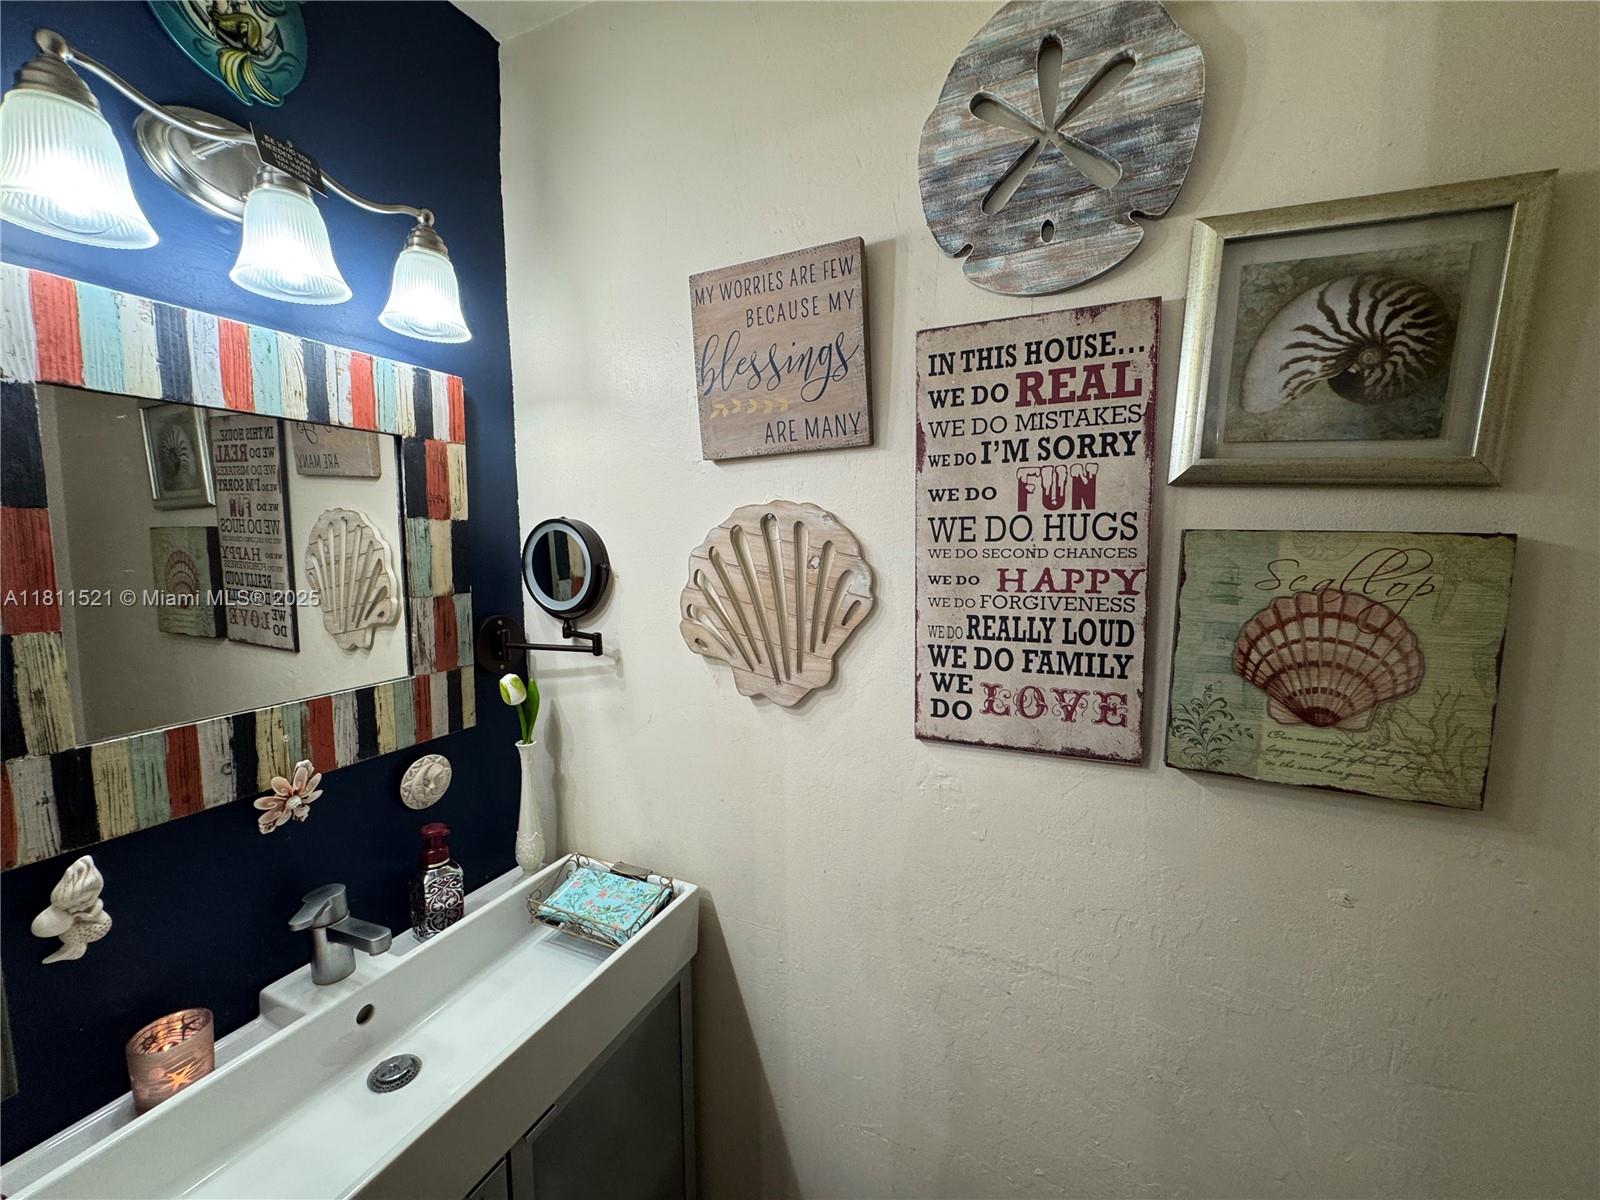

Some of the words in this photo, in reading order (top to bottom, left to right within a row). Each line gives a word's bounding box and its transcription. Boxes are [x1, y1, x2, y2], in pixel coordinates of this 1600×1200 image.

[695, 286, 714, 307] MY
[720, 270, 783, 301] WORRIES
[790, 264, 816, 288] ARE
[823, 255, 854, 280] FEW
[746, 296, 820, 328] BECAUSE
[829, 288, 854, 313] MY
[700, 329, 859, 402] blessings
[928, 351, 955, 377] IN
[961, 343, 1017, 372] THIS
[1024, 330, 1145, 366] HOUSE...
[928, 388, 965, 409] WE
[971, 383, 1009, 405] DO
[1015, 360, 1142, 408] REAL
[765, 420, 798, 444] ARE
[805, 412, 860, 440] MANY
[928, 419, 965, 439] WE
[971, 415, 1007, 436] DO
[1015, 403, 1142, 432] MISTAKES
[928, 454, 950, 468] WE
[954, 452, 976, 467] DO
[980, 438, 1029, 465] I'M
[1037, 430, 1141, 462] SORRY
[928, 488, 959, 503] WE
[965, 486, 997, 501] DO
[1016, 463, 1099, 512] FUN
[928, 516, 976, 543] WE
[985, 514, 1033, 542] DO
[1043, 511, 1138, 542] HUGS
[928, 549, 951, 559] WE
[955, 548, 977, 559] DO
[982, 548, 1048, 559] SECOND
[1054, 547, 1137, 559] CHANCES
[928, 575, 952, 586] WE
[956, 575, 980, 586] DO
[996, 567, 1145, 596] HAPPY
[1255, 547, 1435, 634] Scallop
[928, 597, 950, 608] WE
[954, 597, 976, 608] DO
[980, 594, 1136, 613] FORGIVENESS
[928, 625, 945, 639] WE
[947, 625, 963, 640] DO
[966, 614, 1056, 643] REALLY
[1062, 618, 1135, 647] LOUD
[928, 644, 967, 669] WE
[974, 647, 1014, 672] DO
[1022, 649, 1134, 680] FAMILY
[930, 672, 973, 694] WE
[930, 698, 972, 721] DO
[979, 682, 1129, 728] LOVE
